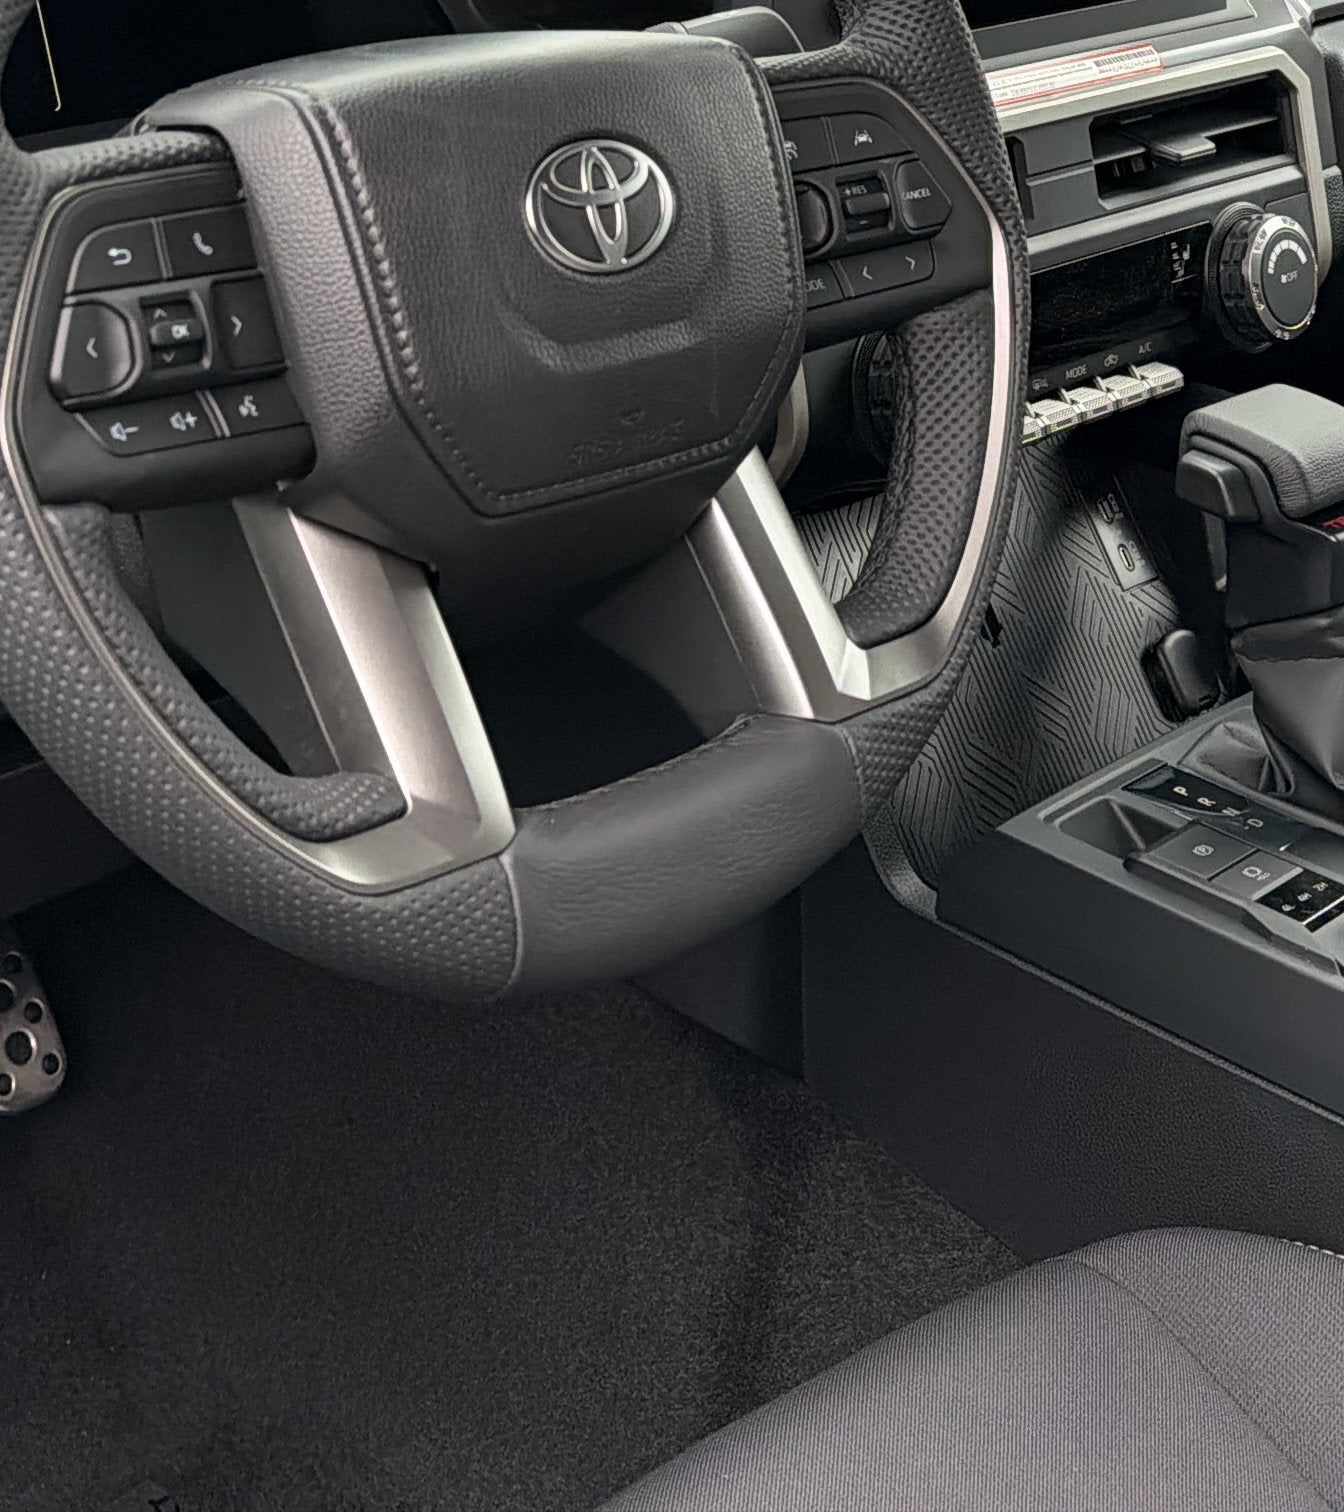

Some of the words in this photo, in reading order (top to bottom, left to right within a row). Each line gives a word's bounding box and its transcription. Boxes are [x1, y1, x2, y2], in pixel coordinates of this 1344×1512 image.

[171, 323, 190, 339] OK
[1138, 341, 1153, 355] A/C
[1065, 364, 1088, 381] MODE
[1172, 785, 1189, 798] P
[1196, 796, 1217, 808] R
[1246, 817, 1264, 828] D
